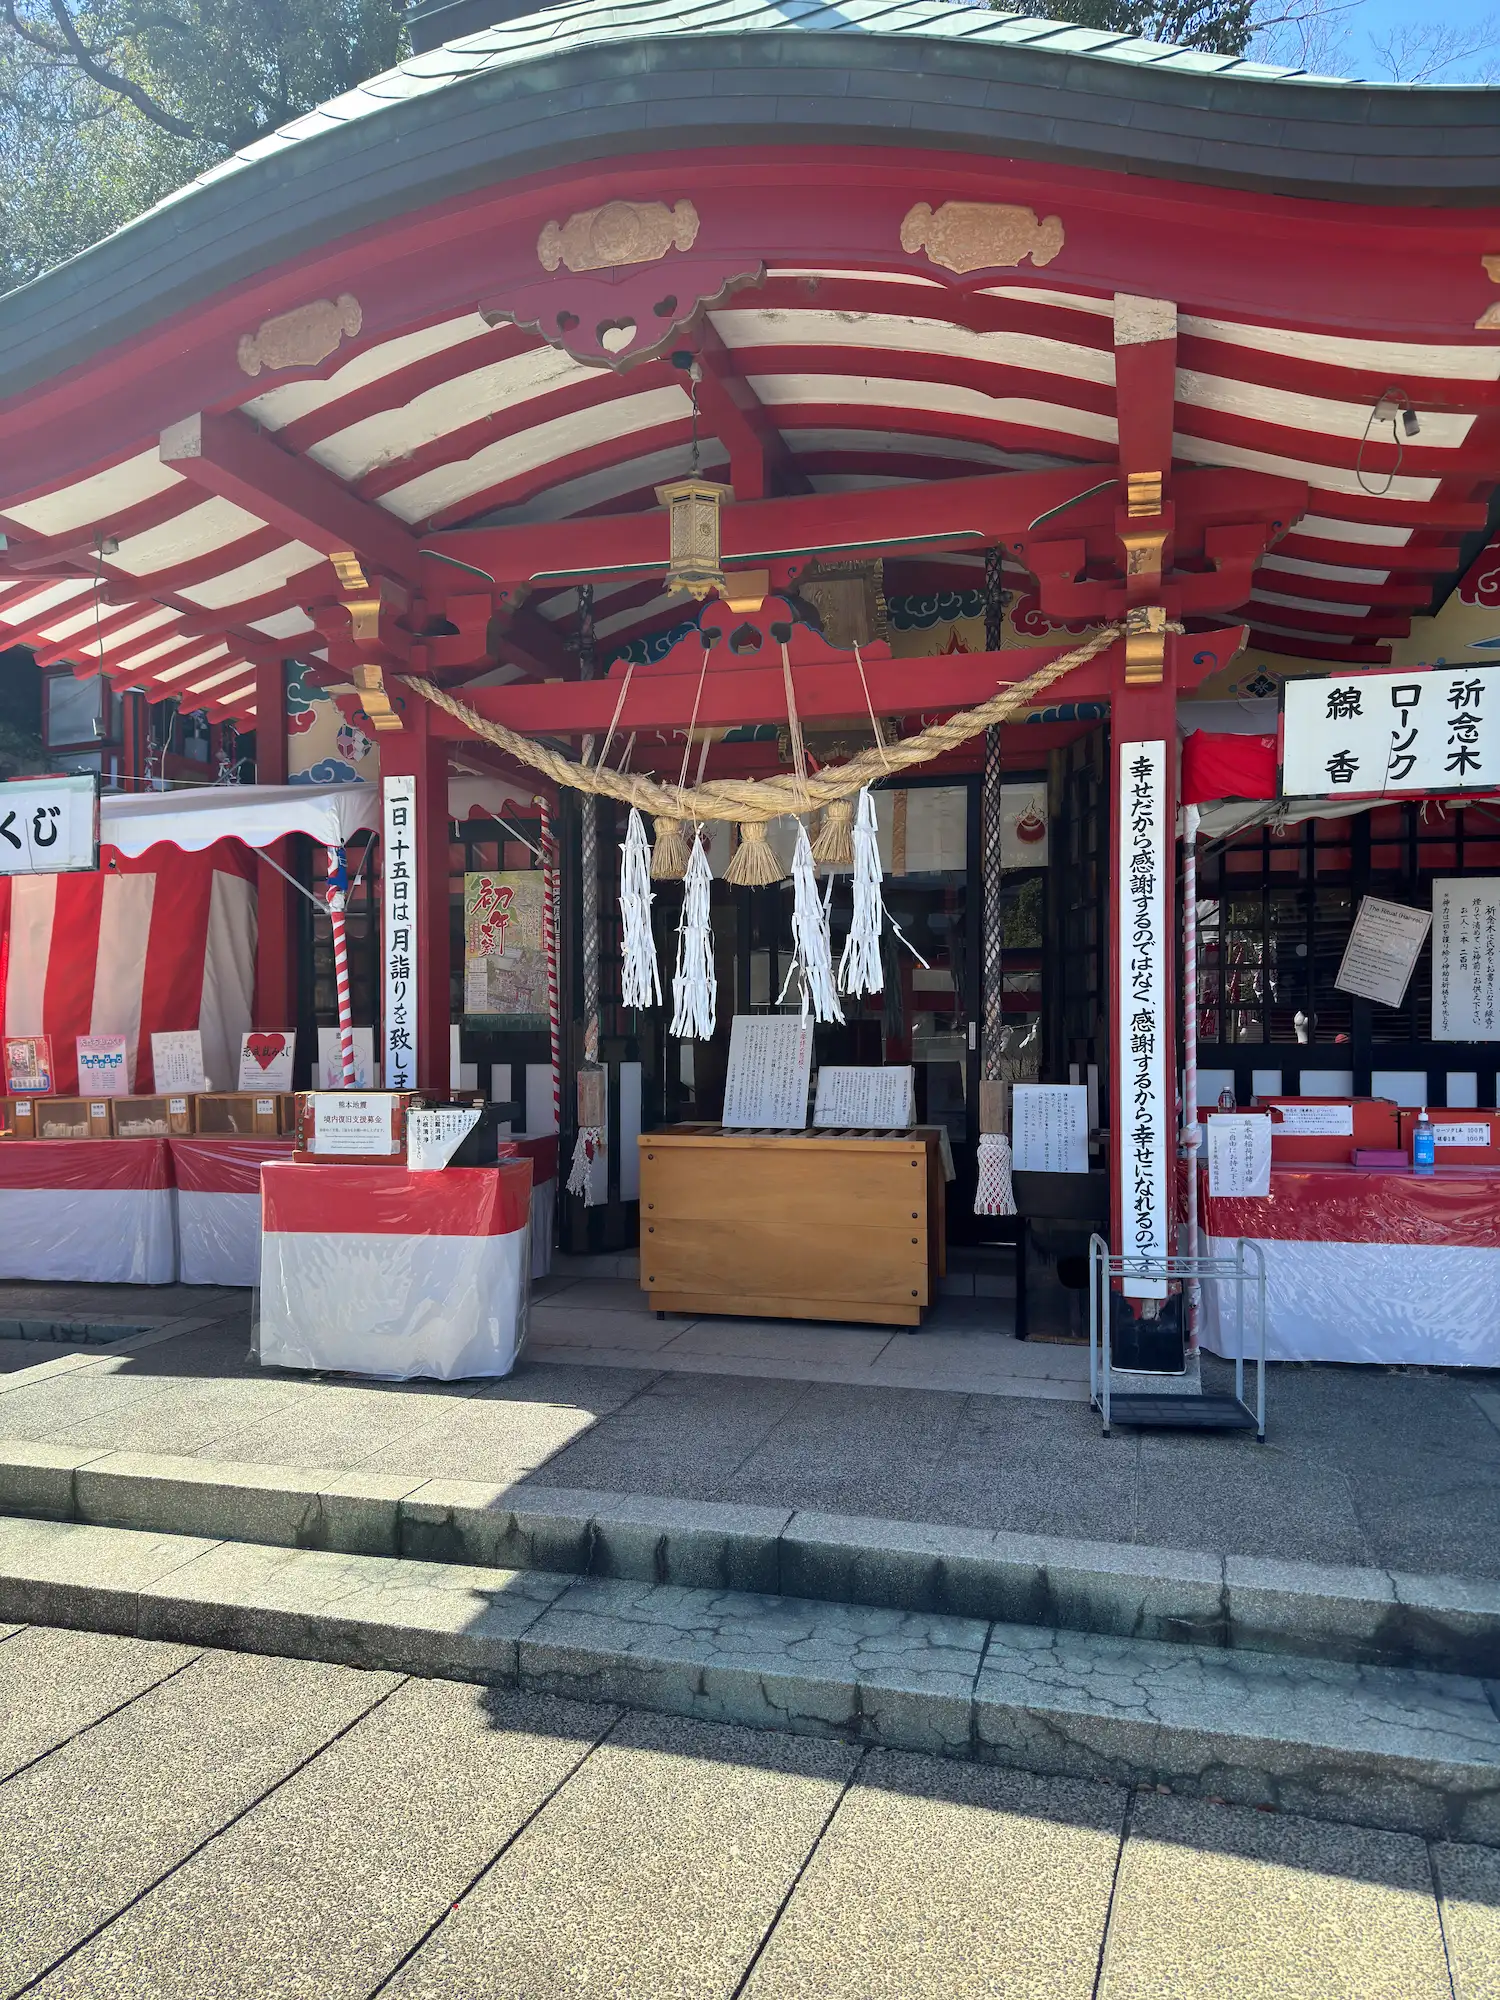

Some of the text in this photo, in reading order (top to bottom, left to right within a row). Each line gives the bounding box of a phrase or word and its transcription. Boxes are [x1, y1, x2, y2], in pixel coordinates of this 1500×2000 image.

[1325, 686, 1364, 784] 線香
[1388, 684, 1422, 780] ローソク
[1444, 678, 1486, 776] 祈念木
[0, 805, 61, 850] くじ
[1369, 904, 1380, 914] The
[1380, 907, 1398, 917] Ritual
[338, 1100, 368, 1110] 熊本地震
